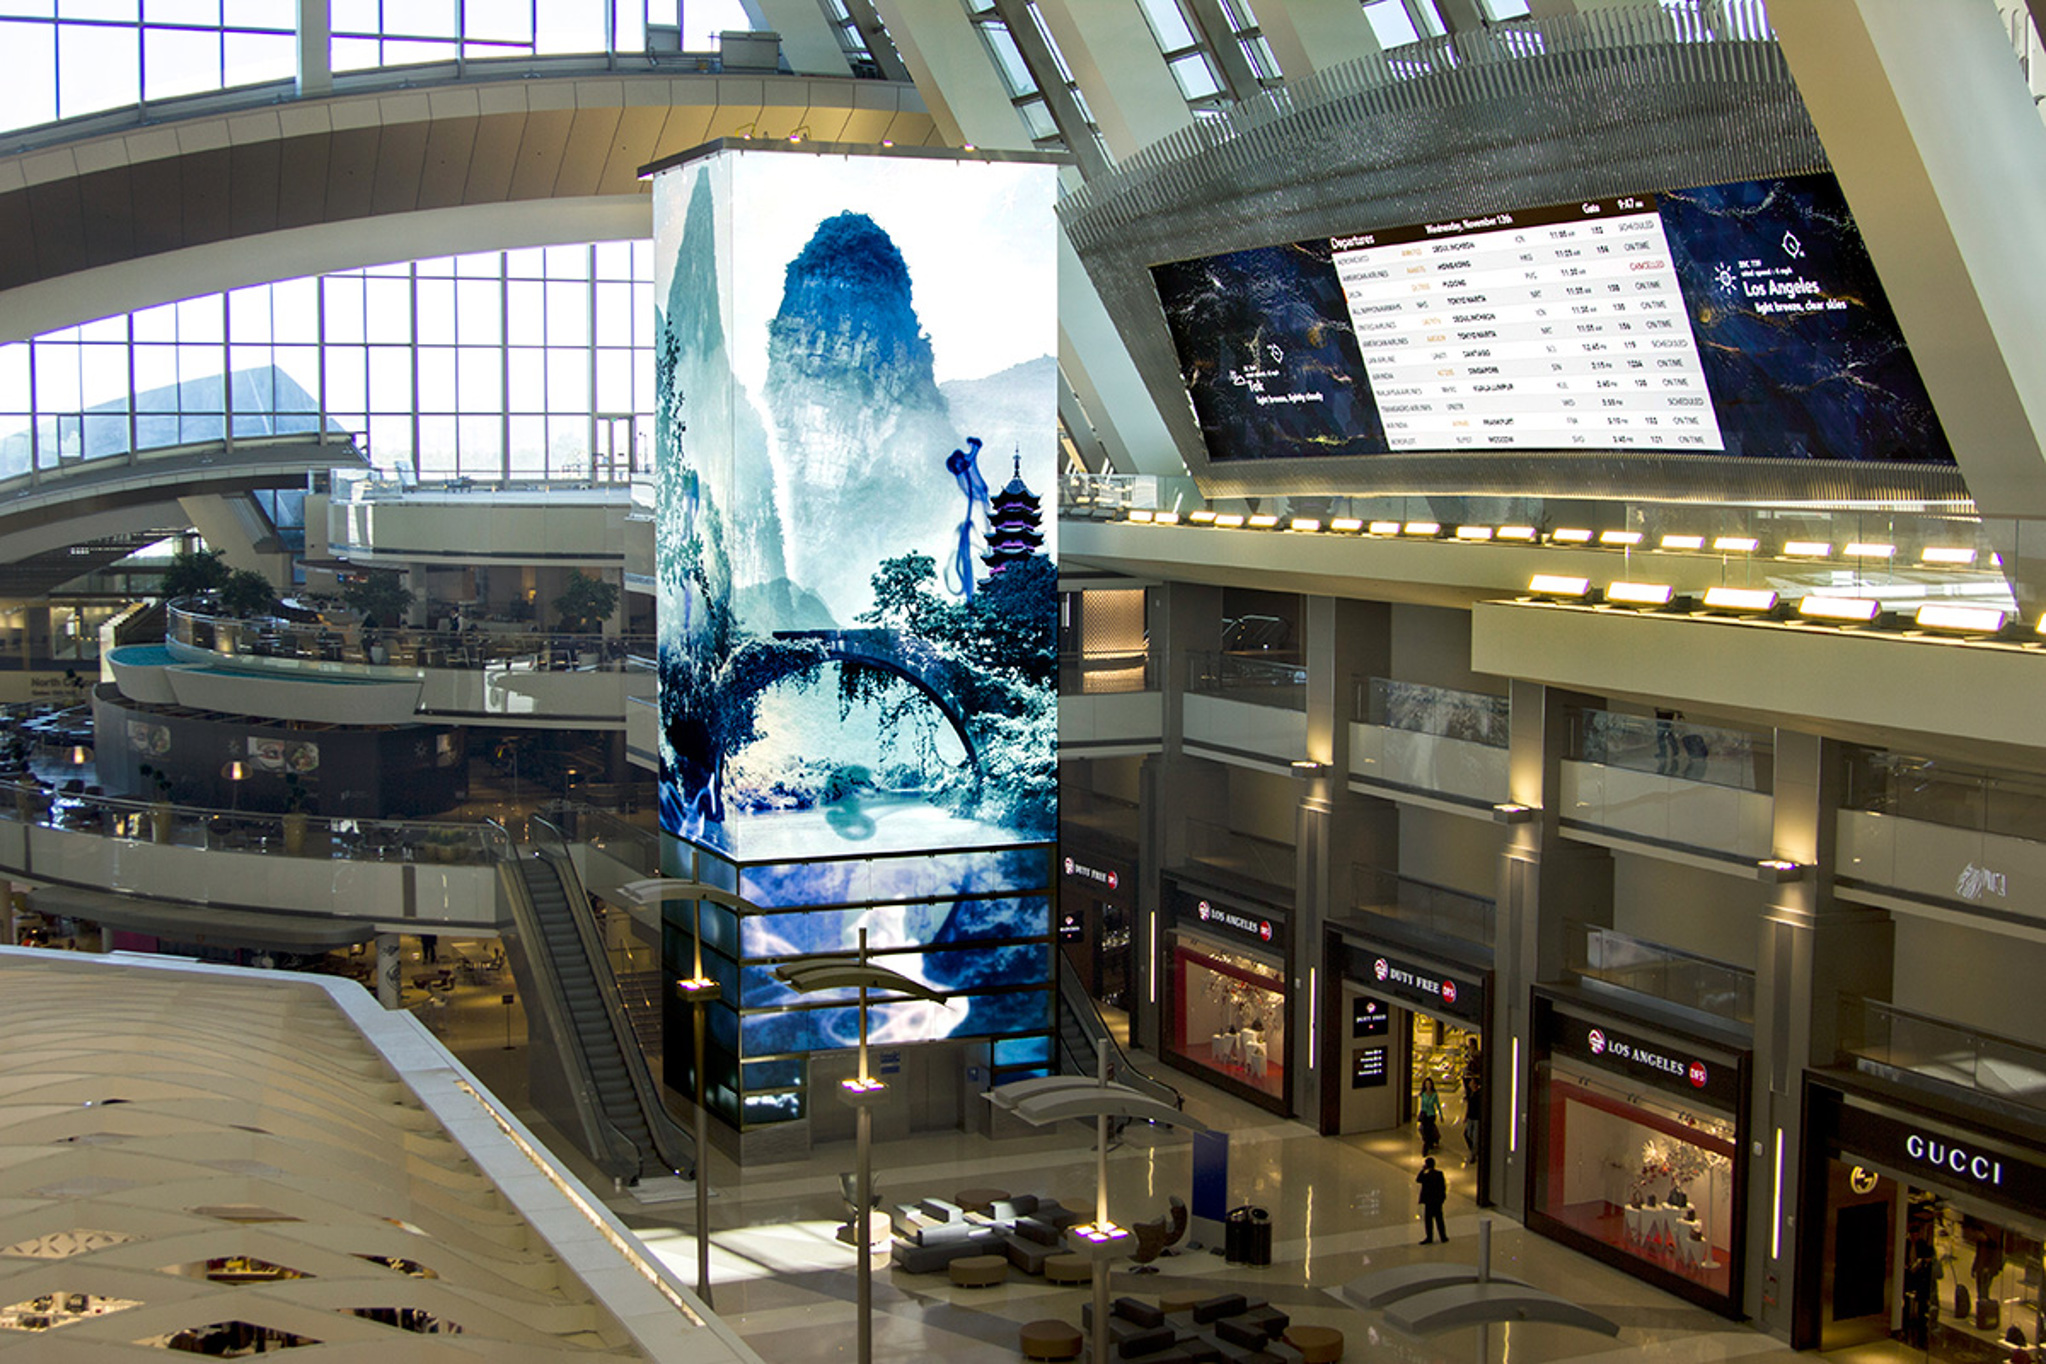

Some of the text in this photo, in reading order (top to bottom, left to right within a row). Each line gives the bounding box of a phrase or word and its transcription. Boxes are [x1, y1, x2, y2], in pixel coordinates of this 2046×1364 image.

[1582, 202, 1601, 214] Gate
[1424, 221, 1463, 235] Wednesday,
[1462, 217, 1498, 229] November
[1330, 235, 1375, 251] Departures
[1742, 276, 1821, 300] Los Angeles
[1805, 299, 1825, 311] clear
[1825, 298, 1847, 310] skies
[1091, 867, 1107, 882] FREE
[1211, 908, 1225, 921] LOS
[1225, 911, 1259, 933] ANGELES
[1390, 967, 1414, 985] DUTY
[1416, 976, 1440, 994] FREE
[1608, 1039, 1705, 1082] LOS ANGELES DFS
[1906, 1134, 2001, 1185] GUCCI
